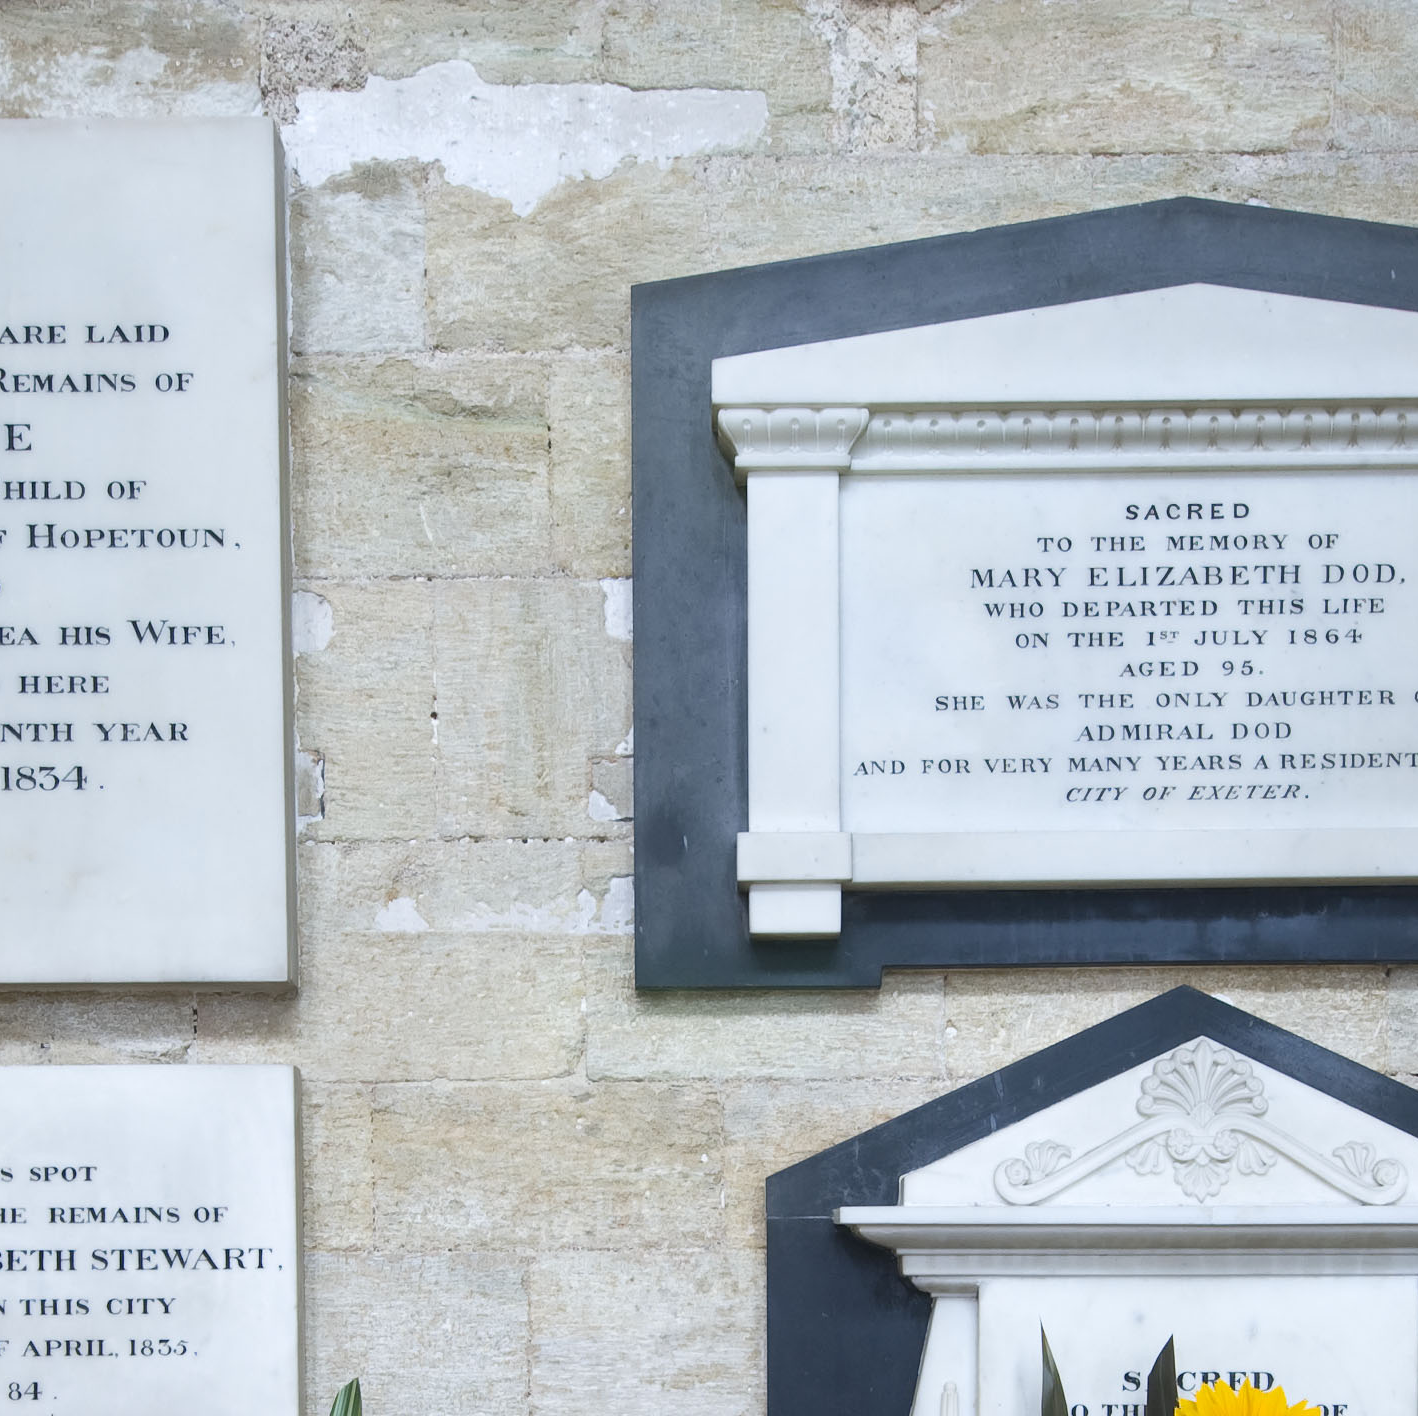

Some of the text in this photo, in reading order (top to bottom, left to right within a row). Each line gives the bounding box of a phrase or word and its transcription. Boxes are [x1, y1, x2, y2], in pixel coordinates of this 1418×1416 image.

[85, 325, 169, 343] LAID
[155, 373, 193, 392] OF
[107, 481, 146, 499] OF
[1126, 503, 1249, 520] SACRED
[1037, 534, 1339, 552] TO THE MEMORY OF
[971, 564, 1405, 588] MARY ELIZABETH DOD,
[984, 598, 1384, 618] WHO DEPARTED THIS LIFE
[59, 627, 110, 645] HIS
[1016, 633, 1048, 648] ON
[1067, 632, 1123, 647] THE
[1194, 630, 1267, 645] JULY
[1290, 629, 1362, 644] 1864
[1120, 660, 1263, 677] AGED 95.
[18, 676, 109, 694] HERE
[93, 722, 188, 741] YEAR
[1077, 722, 1291, 741] ADMIRAL DOD
[1066, 784, 1308, 802] CITY OF EXETER.
[30, 1166, 97, 1182] SPOT
[20, 1299, 89, 1315] THIS
[107, 1298, 175, 1315] CITY
[23, 1340, 118, 1357] APRIL,
